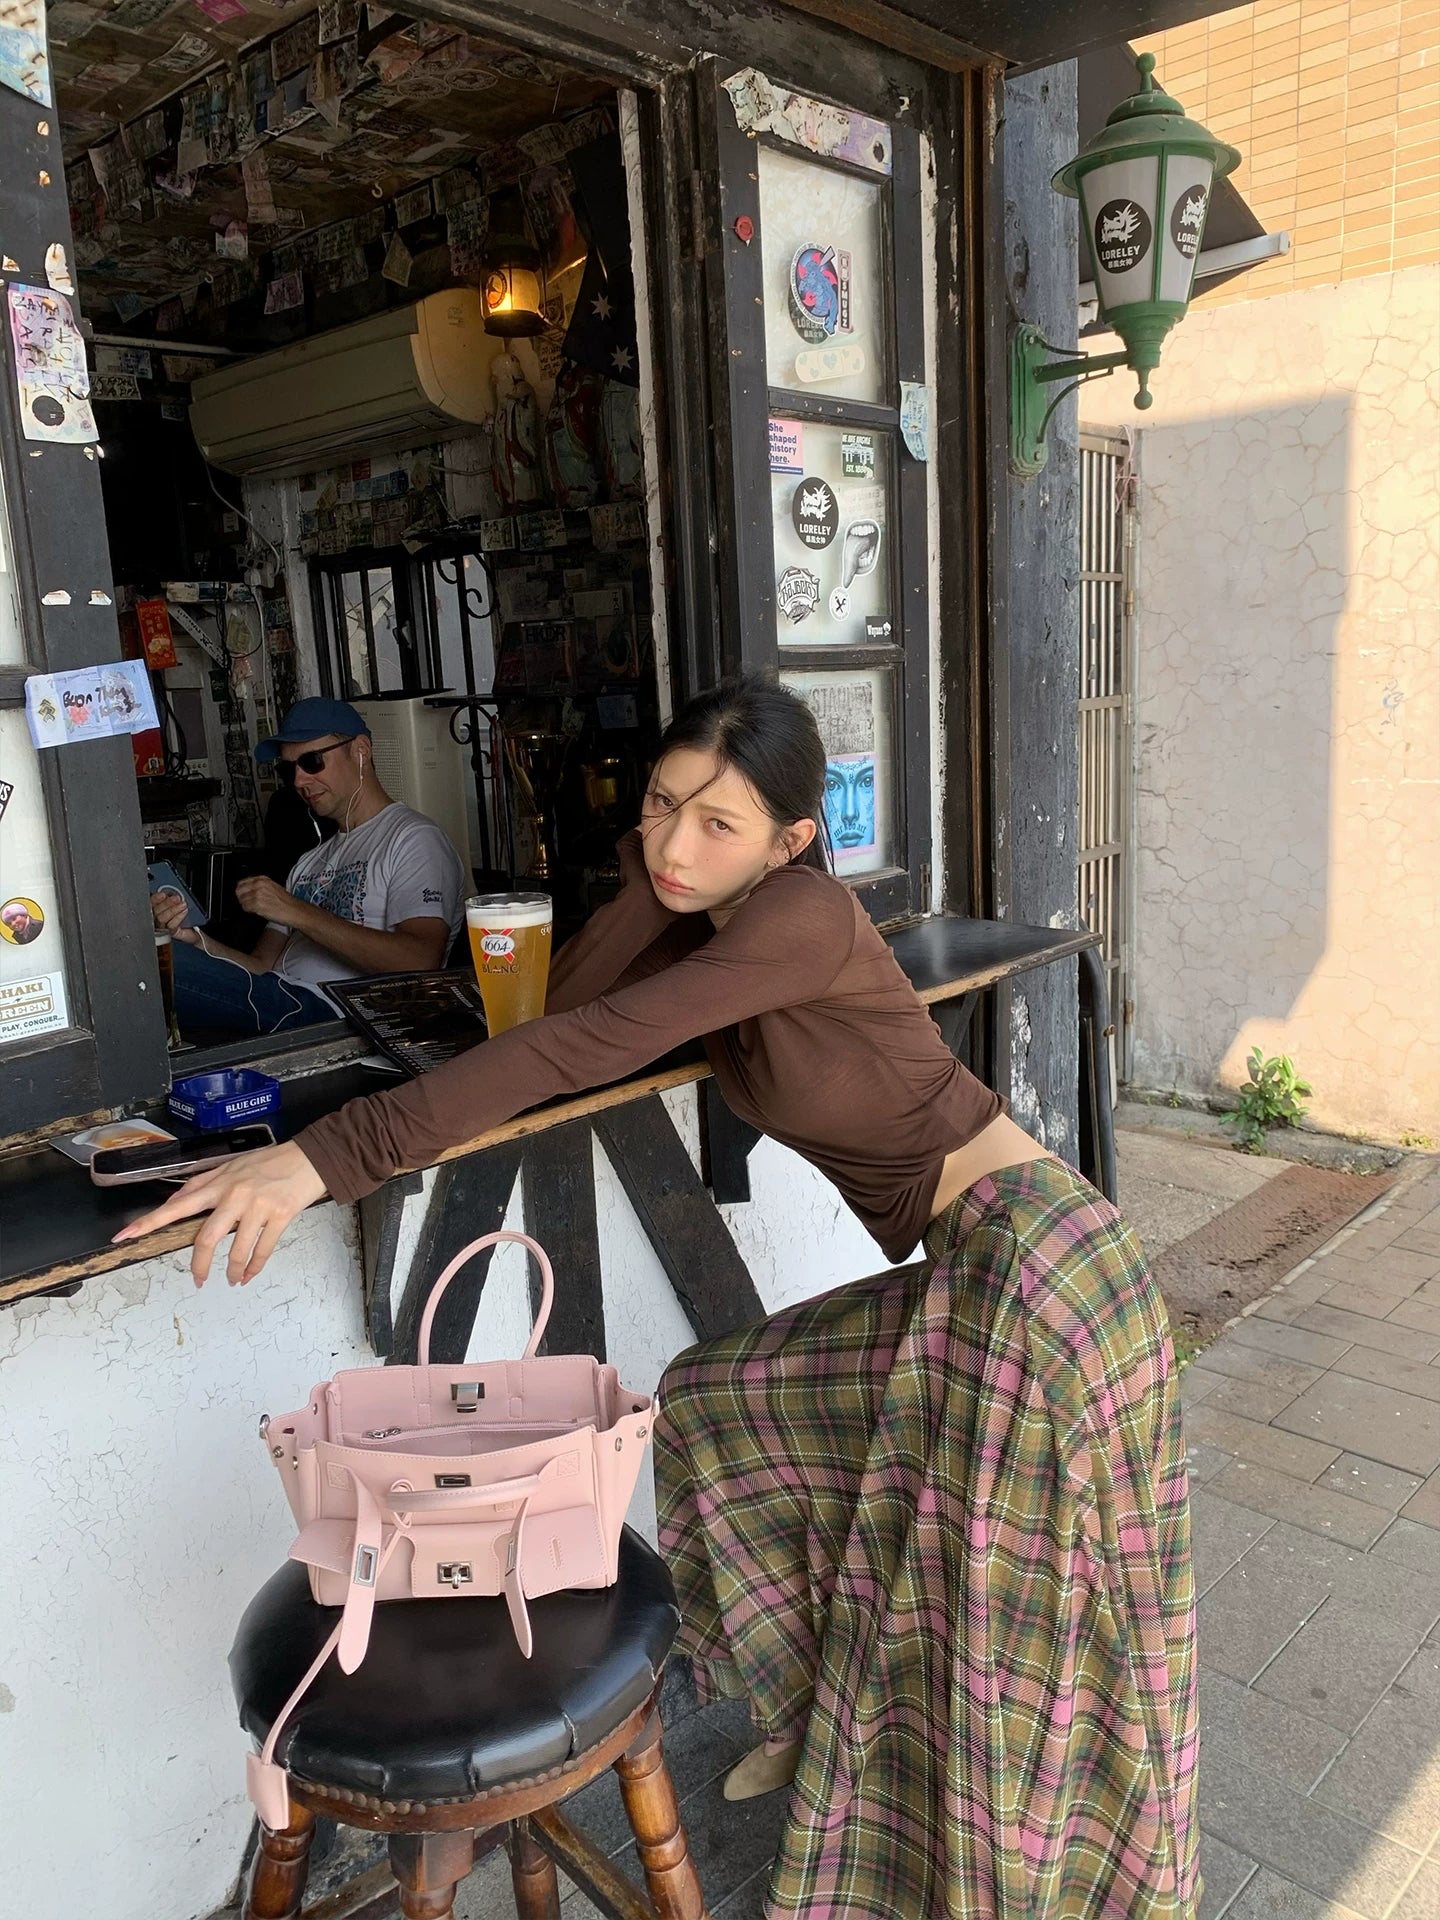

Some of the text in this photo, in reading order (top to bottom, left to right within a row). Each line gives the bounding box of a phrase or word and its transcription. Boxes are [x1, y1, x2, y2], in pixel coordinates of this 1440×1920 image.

[1101, 245, 1140, 261] LORELEY
[768, 422, 784, 432] She
[768, 433, 797, 444] shaped
[769, 444, 797, 455] history
[770, 454, 790, 463] here.
[800, 523, 831, 536] LORELEY
[484, 939, 508, 952] 1664
[482, 963, 519, 974] BLANC
[0, 982, 44, 999] HAKI
[0, 1000, 50, 1020] REEN
[2, 1023, 23, 1033] PLAY,
[169, 1098, 195, 1115] BLUE GIRL
[225, 1100, 249, 1113] BLUE
[249, 1094, 272, 1106] GIRL
